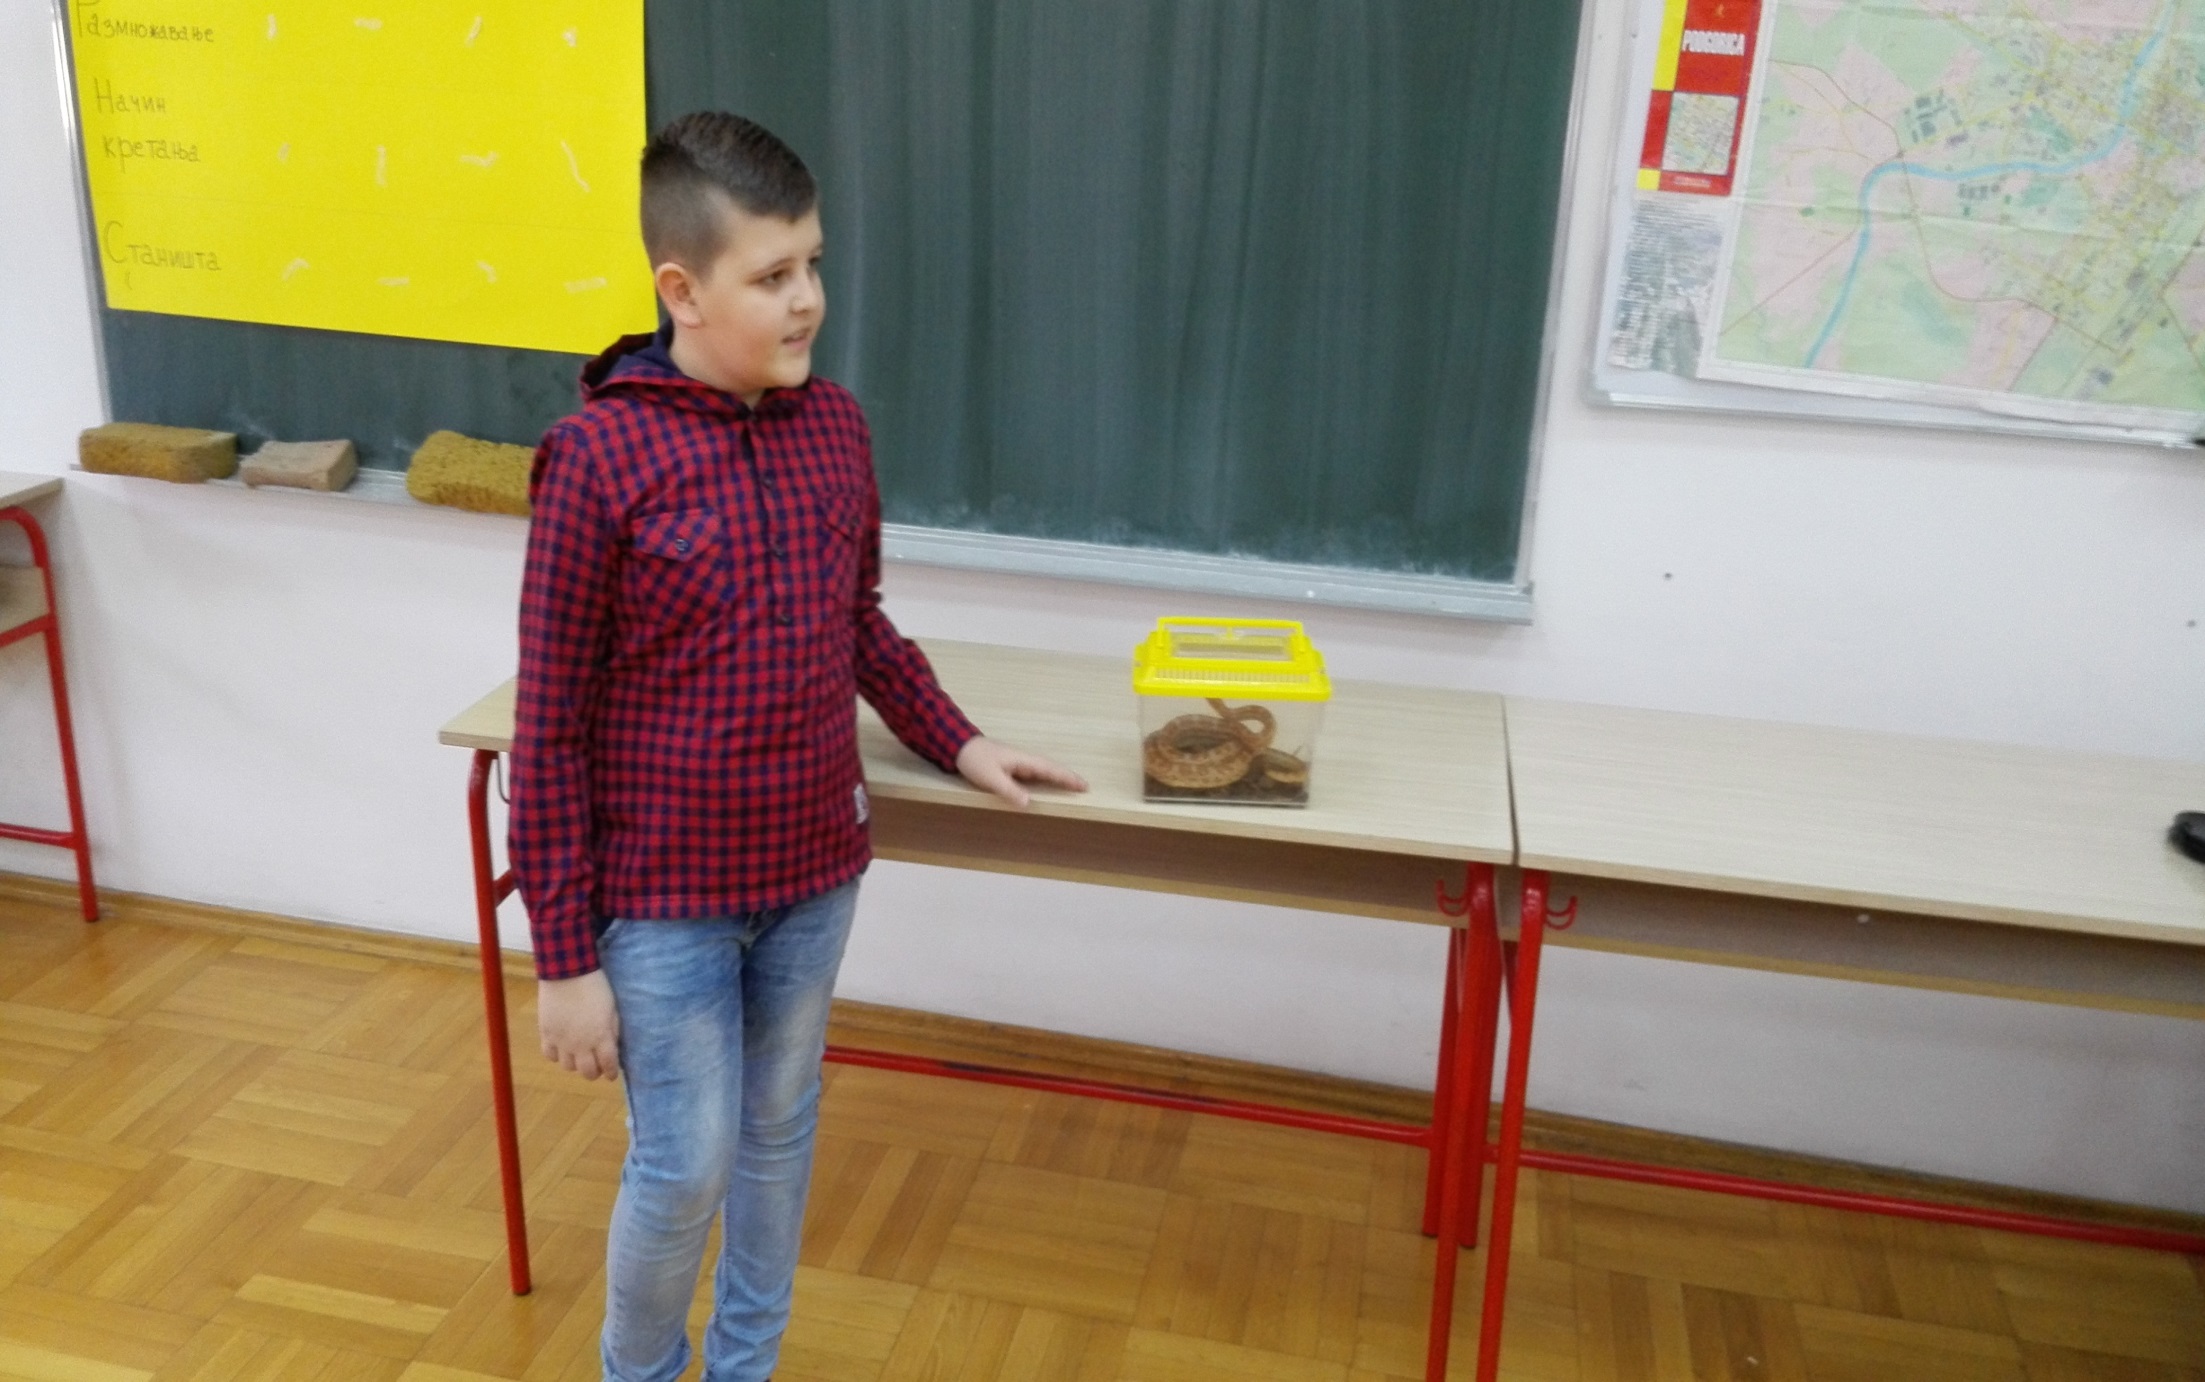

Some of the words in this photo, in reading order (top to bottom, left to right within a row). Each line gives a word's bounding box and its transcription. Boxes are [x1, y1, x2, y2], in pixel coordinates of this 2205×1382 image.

[94, 77, 166, 114] Начин
[103, 135, 201, 174] кретања
[103, 220, 222, 271] Станишта
